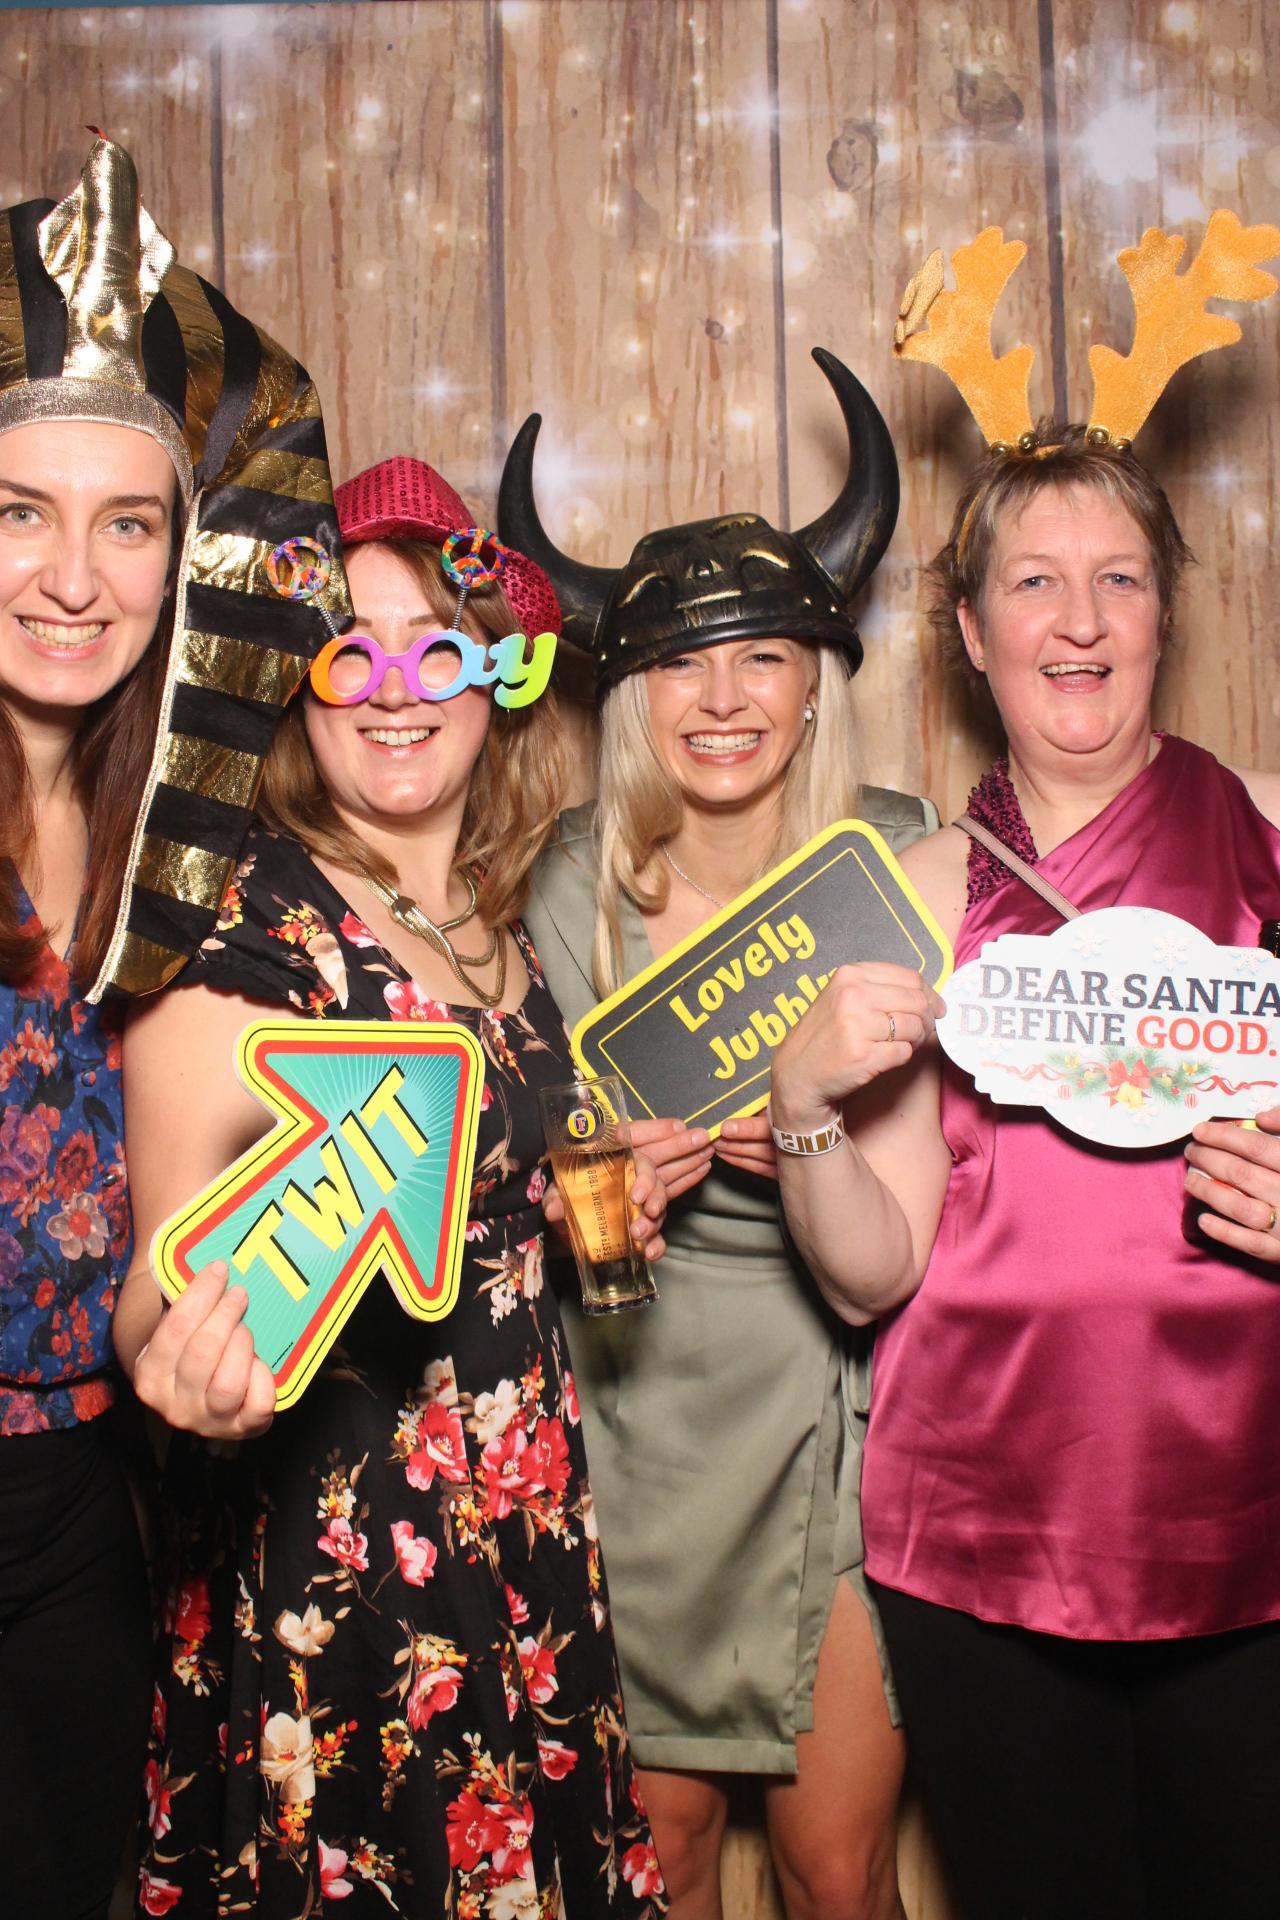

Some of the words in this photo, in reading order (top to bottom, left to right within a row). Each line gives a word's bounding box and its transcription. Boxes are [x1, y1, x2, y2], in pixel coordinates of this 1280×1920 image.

[669, 914, 816, 1033] Lovely
[979, 964, 1111, 1006] DEAR
[1122, 973, 1280, 1018] SANTA
[709, 968, 839, 1079] Jubbl
[957, 1003, 1126, 1047] DEFINE
[1136, 1015, 1278, 1057] GOOD.
[232, 1061, 429, 1301] TWIT
[591, 1190, 609, 1237] MELBOURNE
